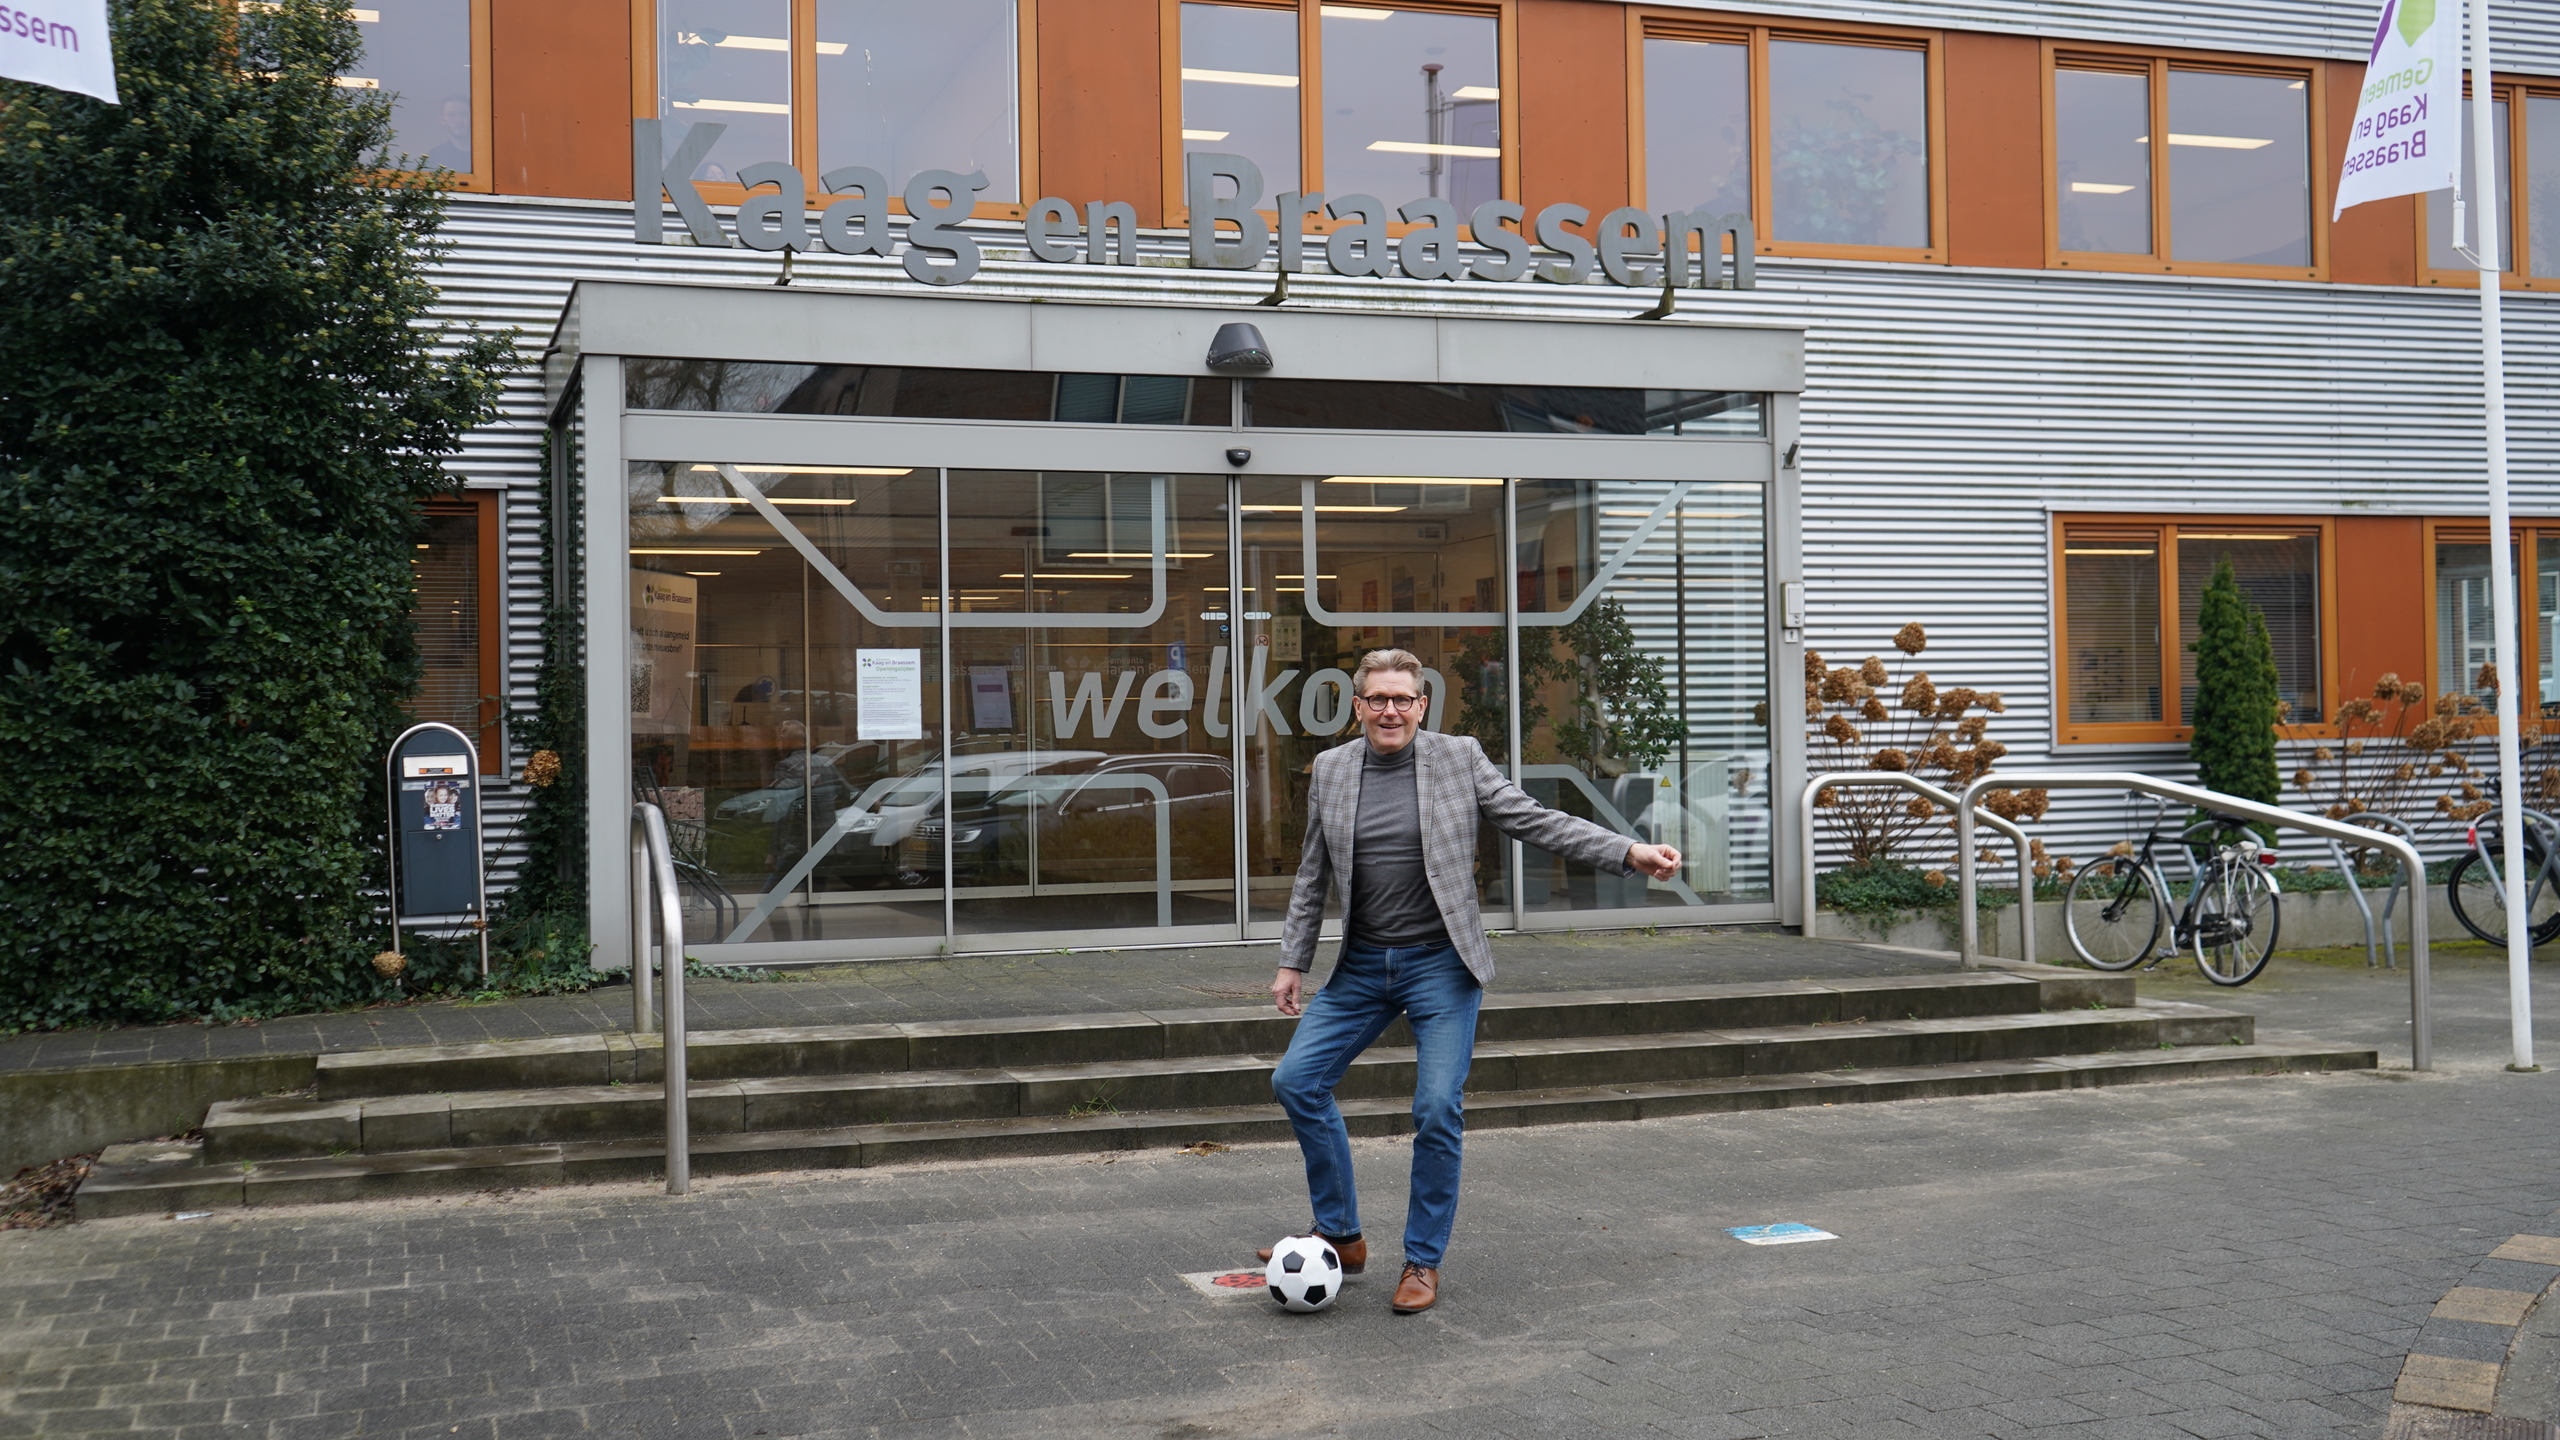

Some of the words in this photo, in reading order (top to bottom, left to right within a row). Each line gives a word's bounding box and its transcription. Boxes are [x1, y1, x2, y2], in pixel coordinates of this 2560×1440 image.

[634, 118, 990, 286] Kaag
[1025, 196, 1138, 266] en
[1187, 151, 1756, 290] Braassem
